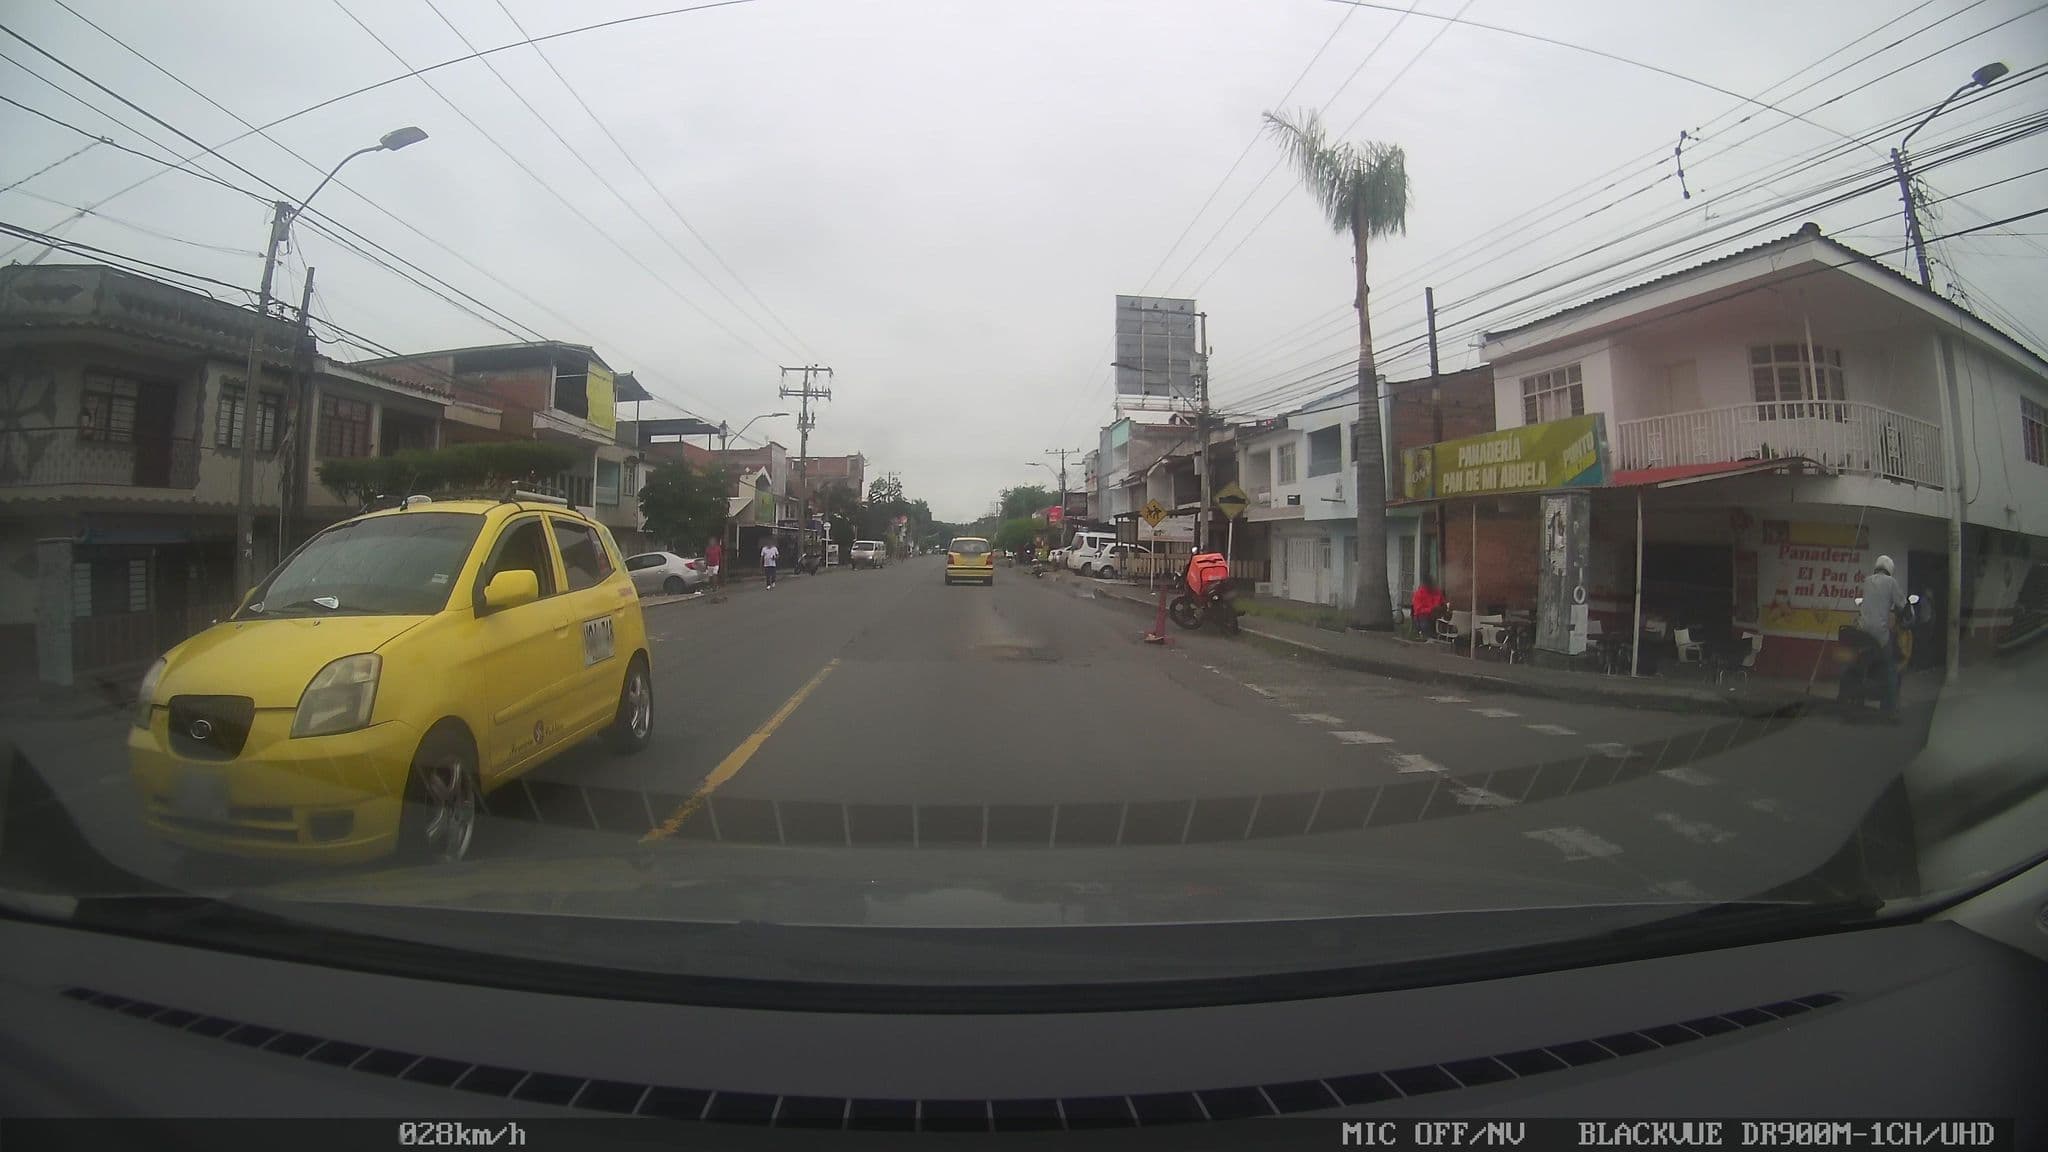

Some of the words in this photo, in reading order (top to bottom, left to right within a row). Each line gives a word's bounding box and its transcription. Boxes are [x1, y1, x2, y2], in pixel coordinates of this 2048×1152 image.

[1443, 470, 1464, 494] PAN
[1465, 469, 1480, 491] DE
[1481, 467, 1498, 490] MI
[1500, 461, 1547, 488] ABUELA
[1798, 566, 1814, 581] El
[1821, 567, 1848, 583] Pan
[1794, 583, 1814, 597] mi
